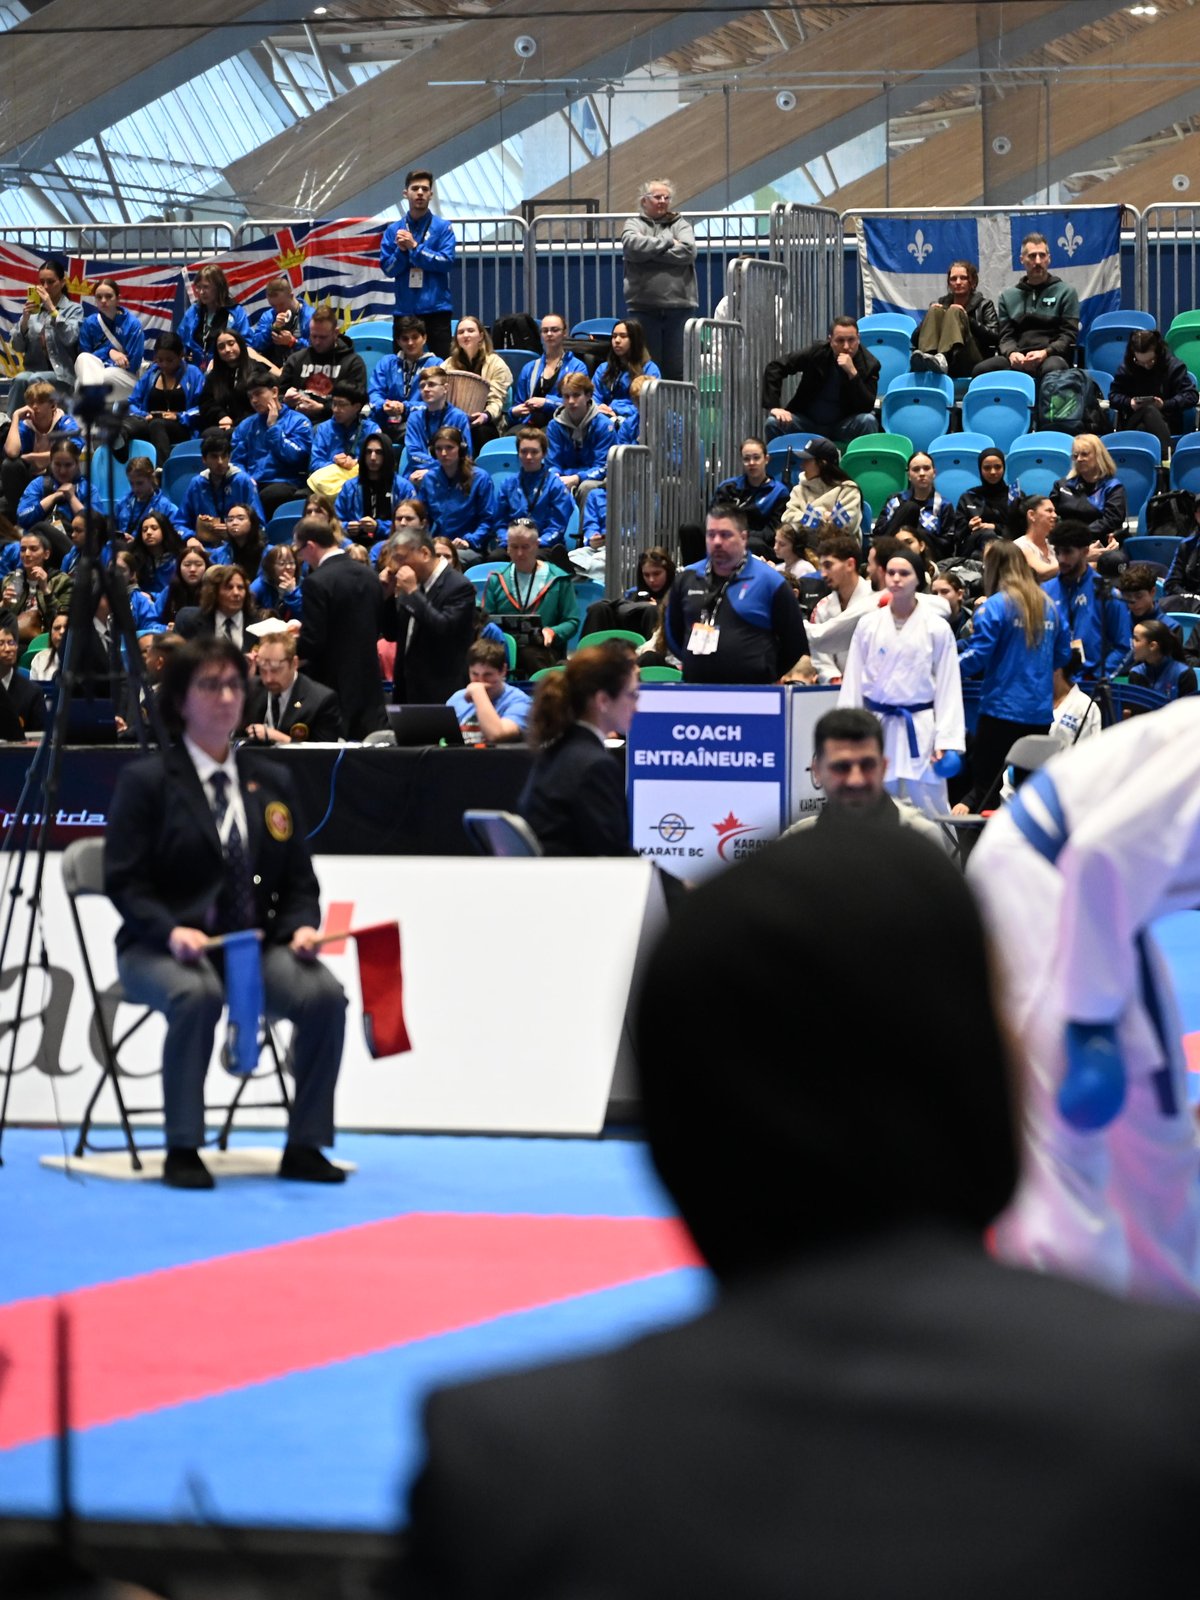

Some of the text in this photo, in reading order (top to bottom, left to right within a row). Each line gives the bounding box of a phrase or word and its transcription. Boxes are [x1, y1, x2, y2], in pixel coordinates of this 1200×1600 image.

[671, 724, 742, 741] COACH
[733, 838, 771, 849] KARAT
[639, 847, 705, 858] KARATE BC
